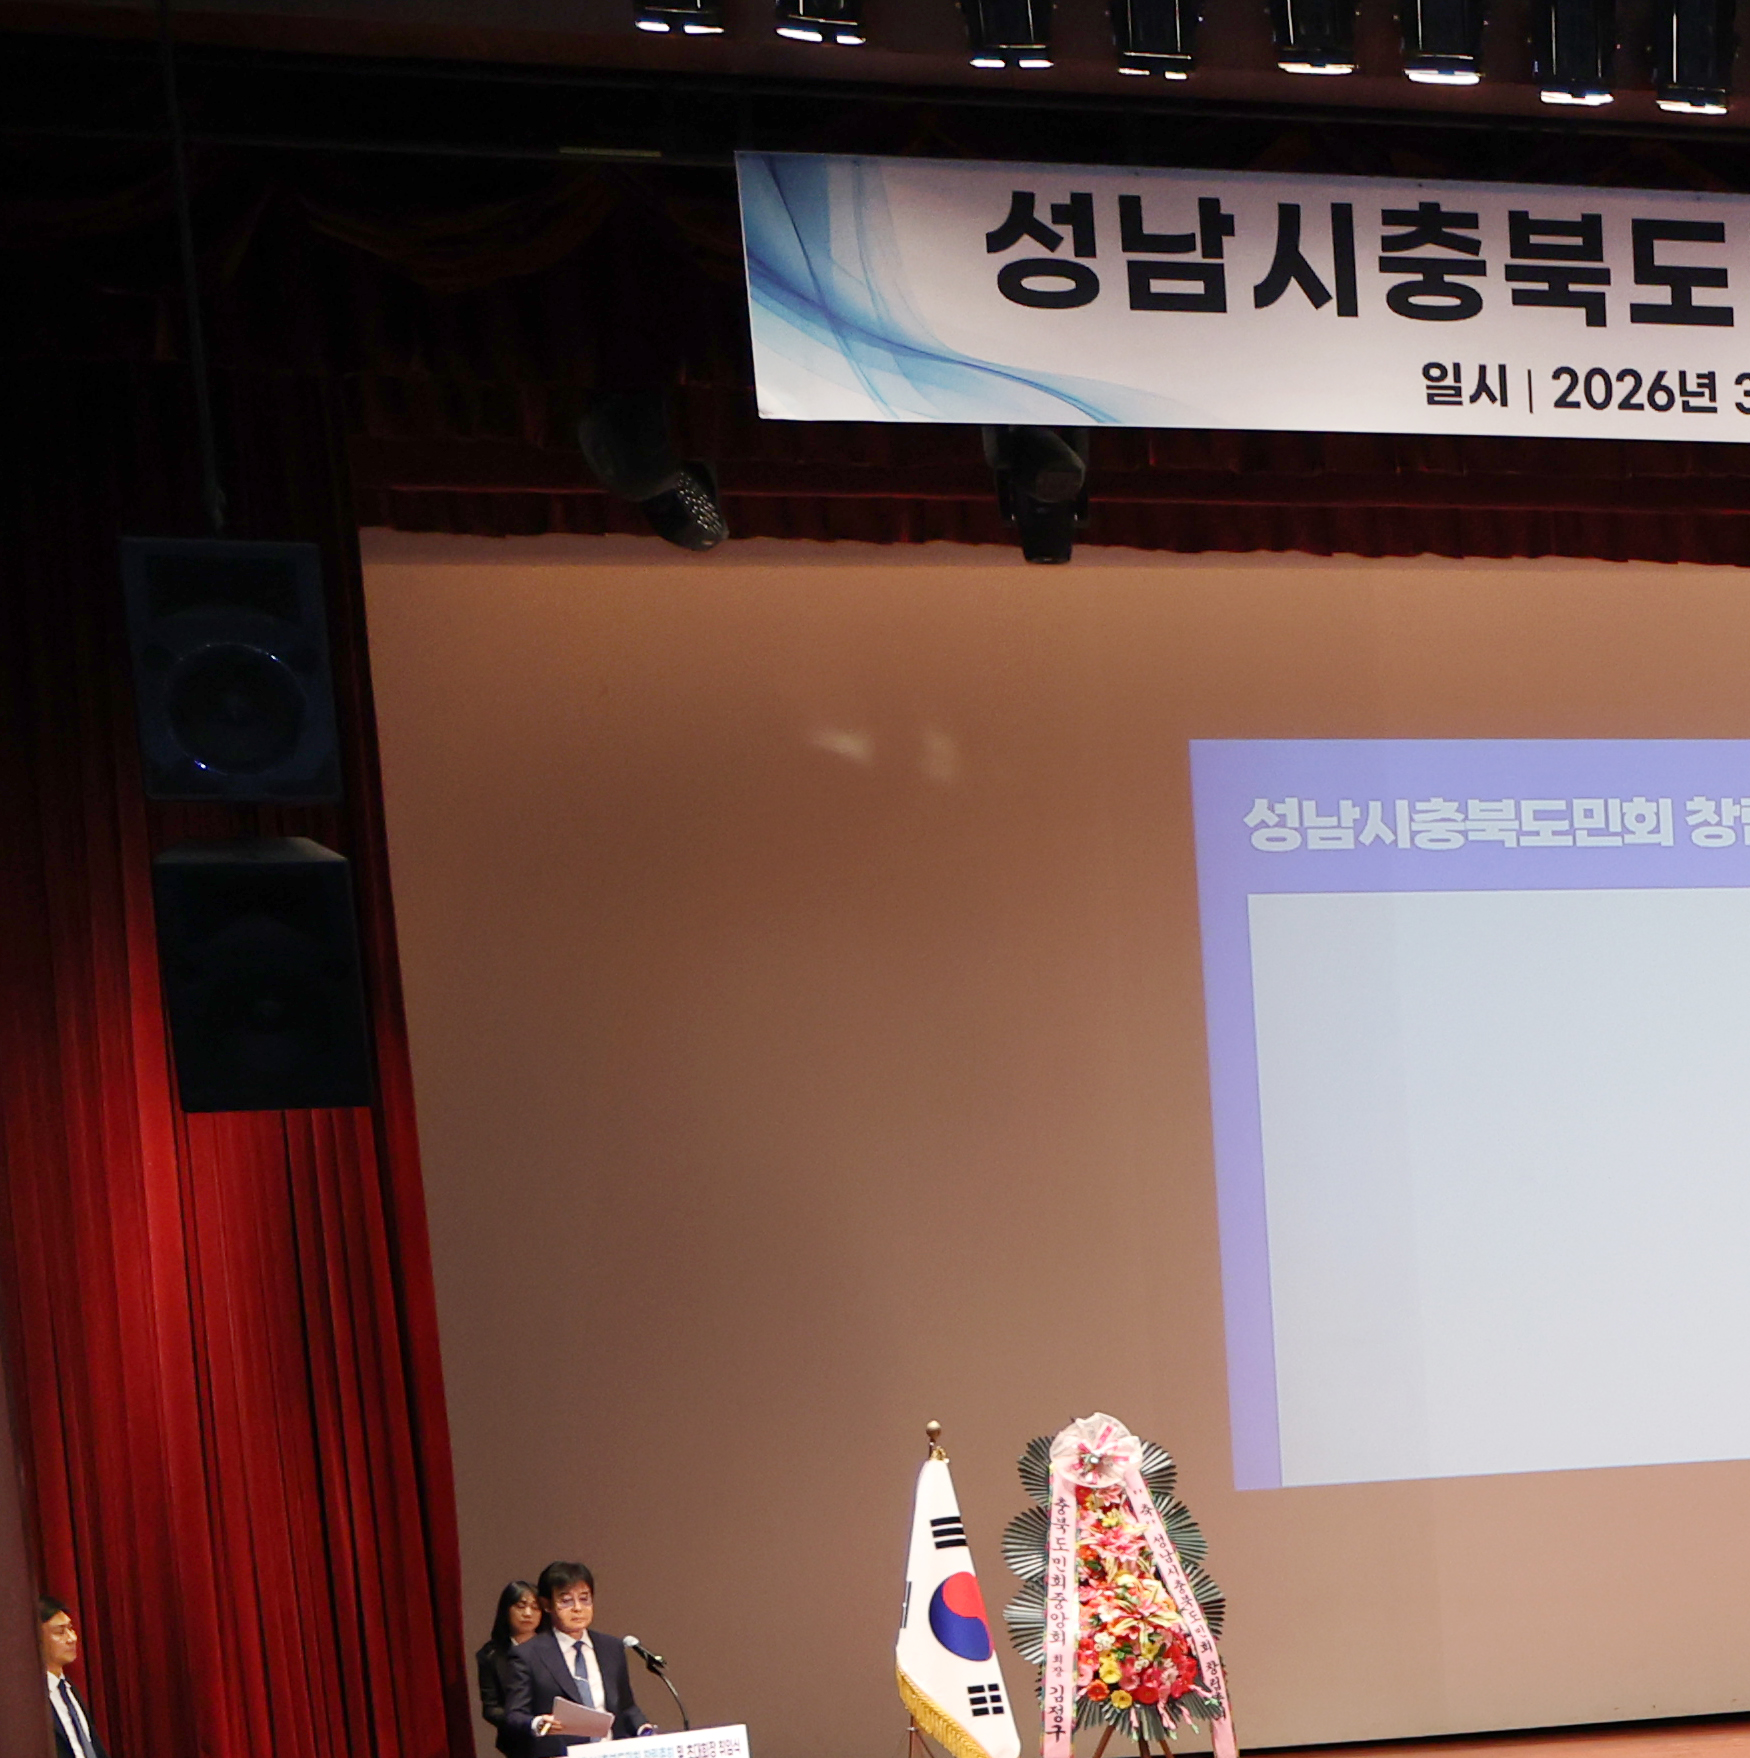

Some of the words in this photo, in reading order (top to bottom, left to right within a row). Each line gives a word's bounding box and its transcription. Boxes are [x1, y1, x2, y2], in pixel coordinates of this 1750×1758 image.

[1422, 362, 1509, 407] 일시
[1552, 367, 1717, 413] 2026년
[1243, 796, 1675, 851] 성남시충북도민회
[1045, 1684, 1066, 1743] 김정구
